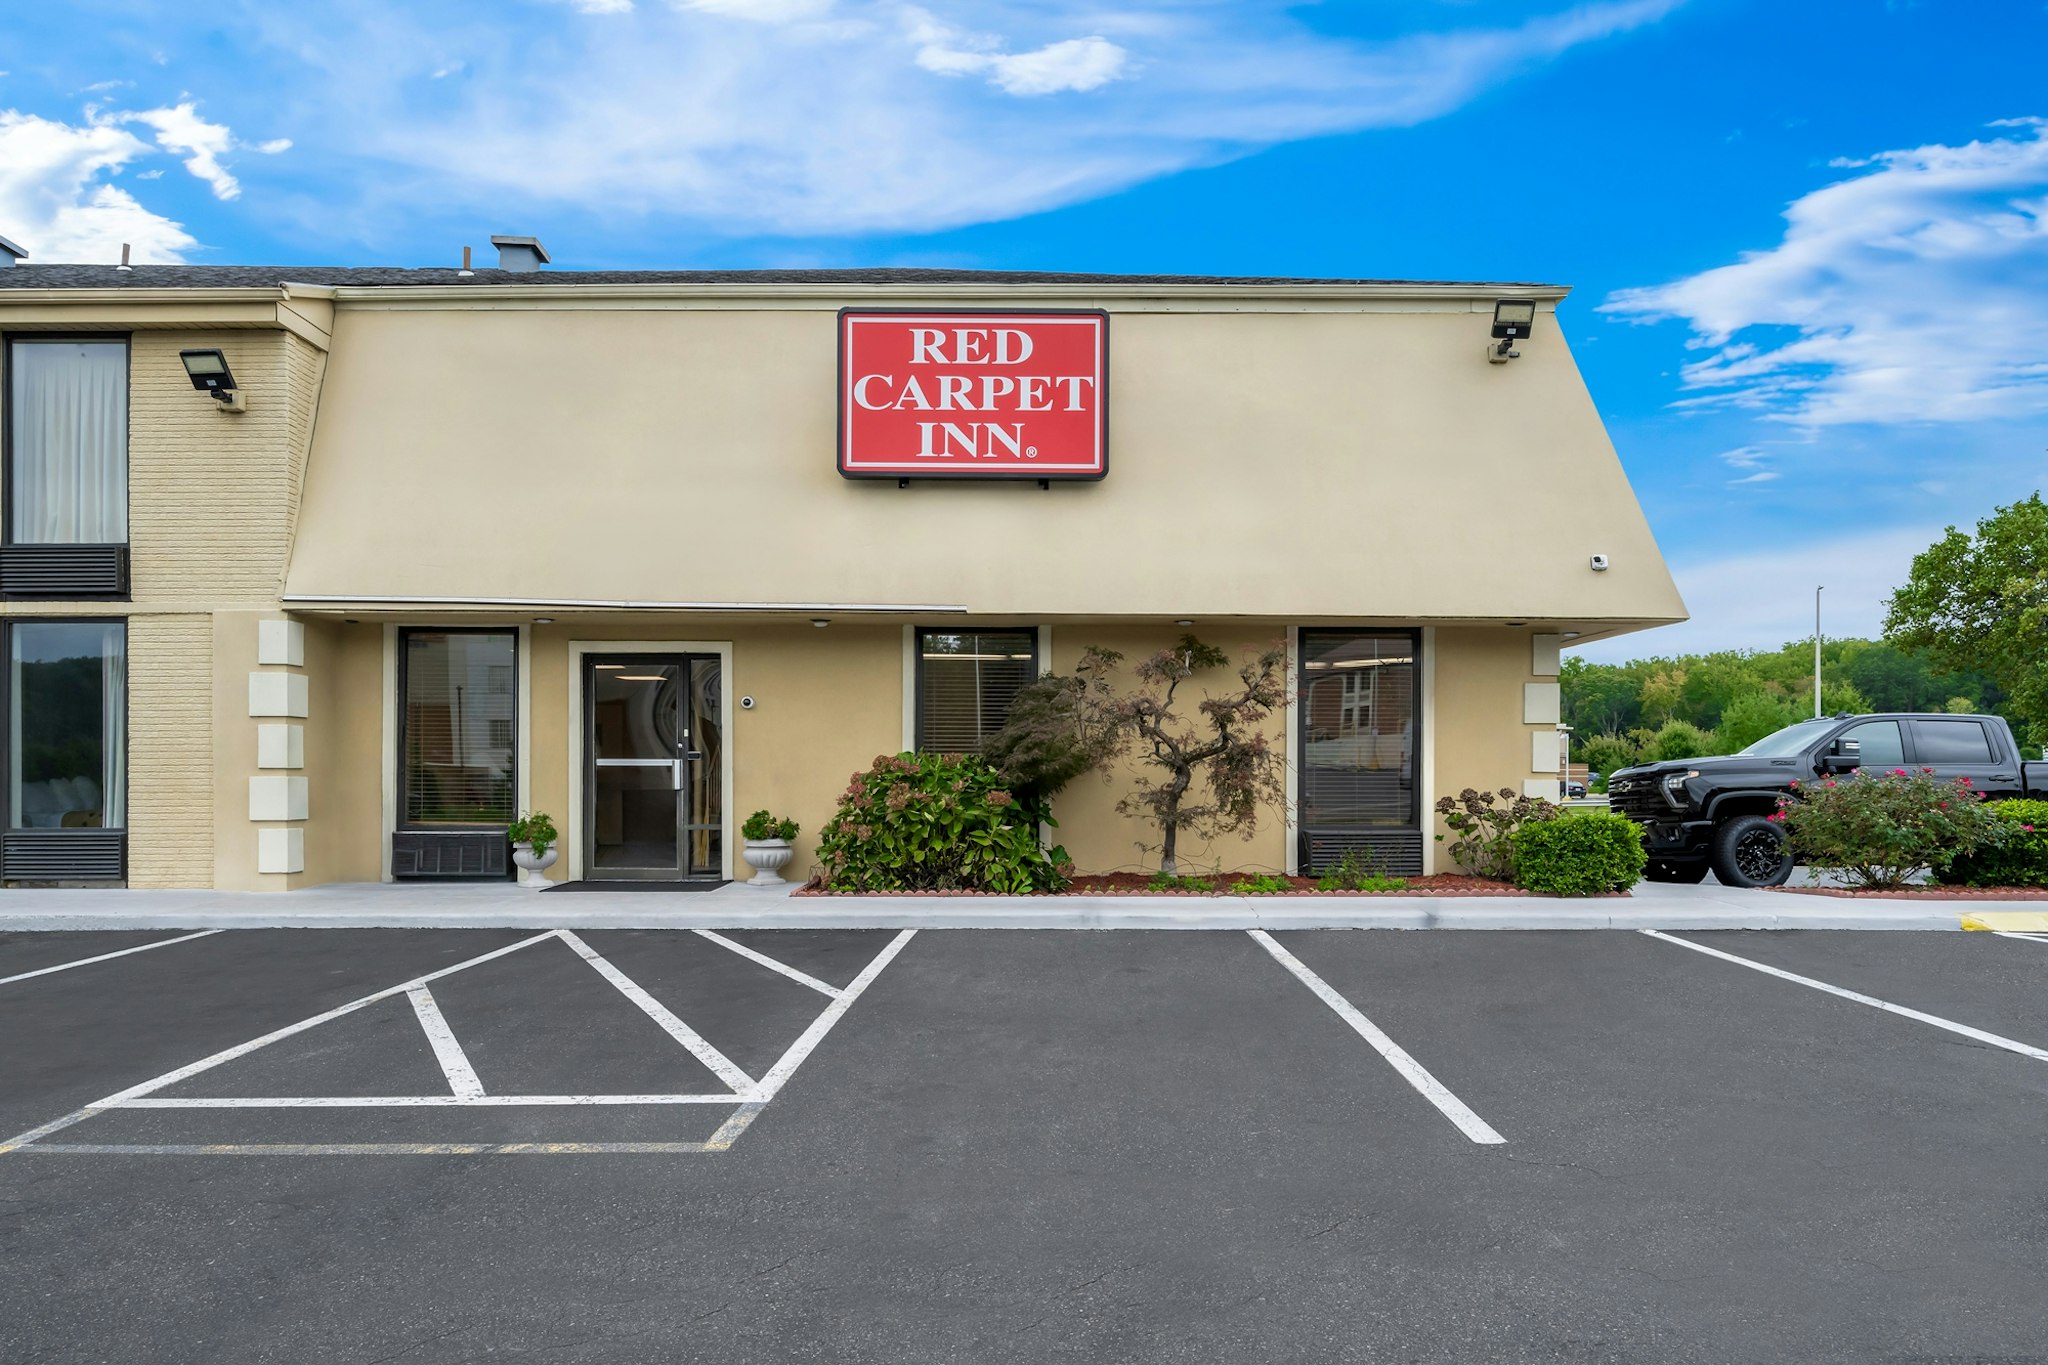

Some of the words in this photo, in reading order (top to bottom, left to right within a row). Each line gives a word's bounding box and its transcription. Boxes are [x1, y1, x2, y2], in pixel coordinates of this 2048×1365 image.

[908, 328, 1034, 365] RED
[853, 374, 1094, 411] CARPET
[915, 422, 1026, 458] INN
